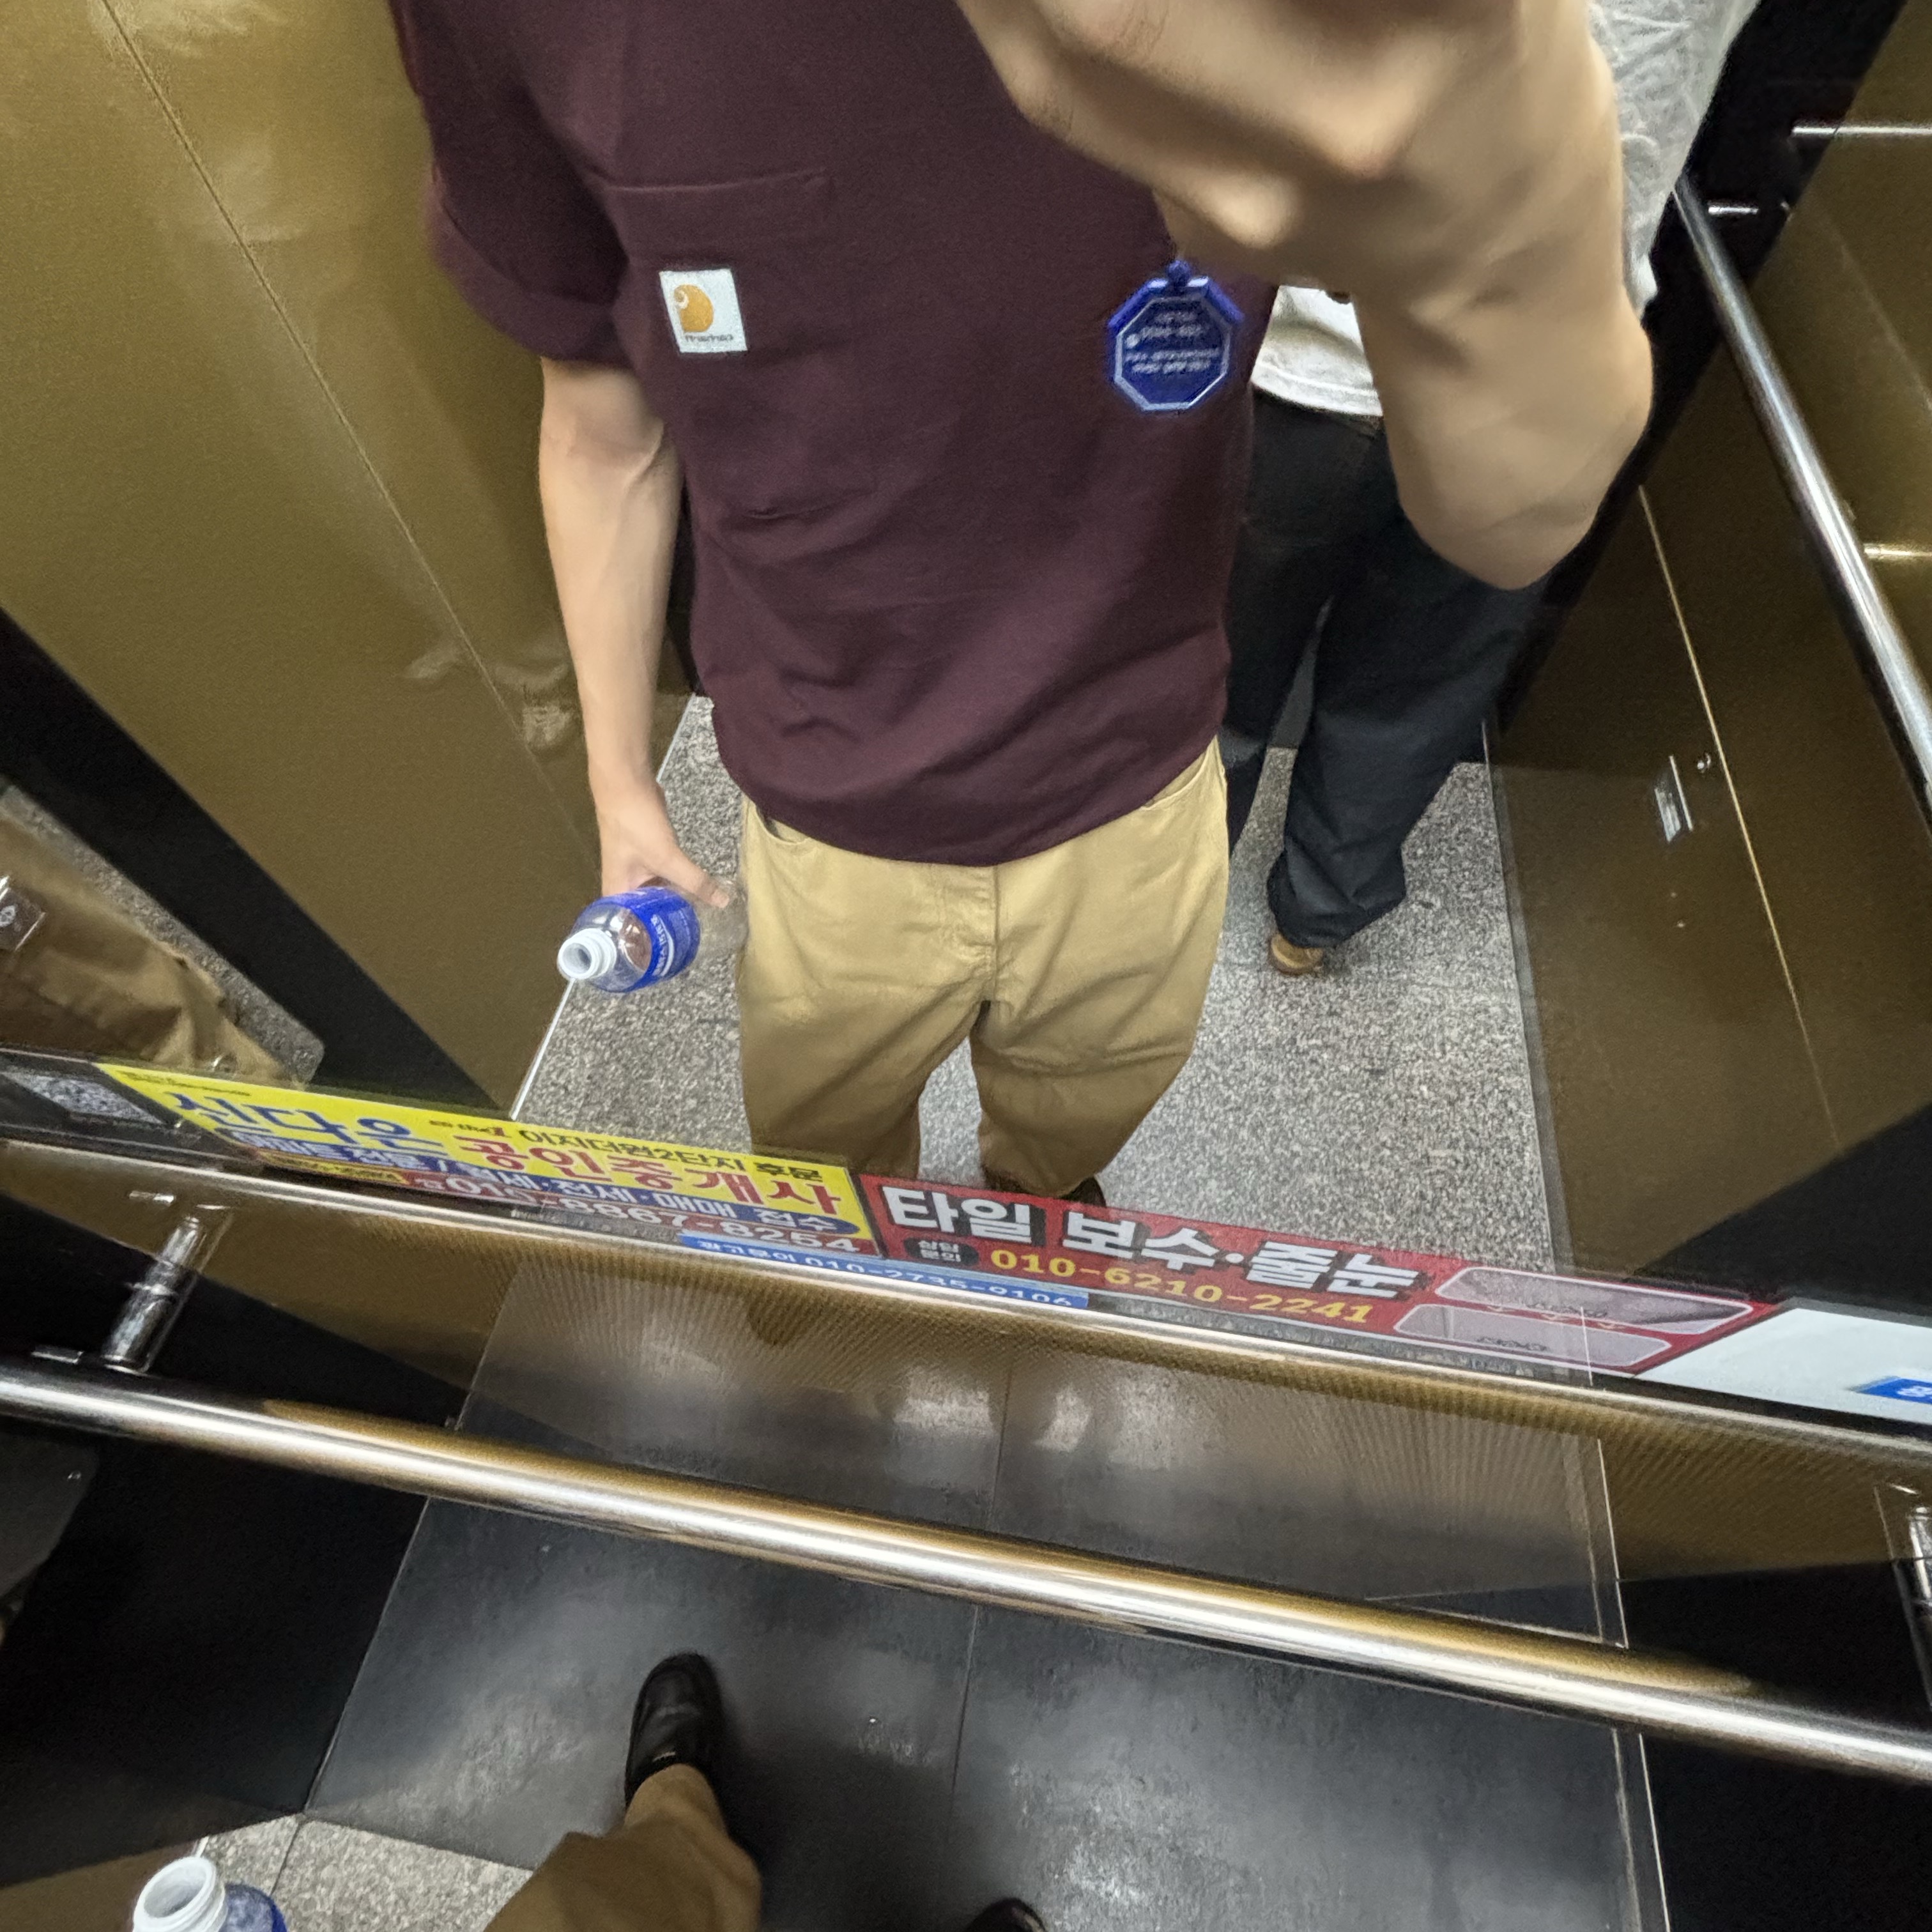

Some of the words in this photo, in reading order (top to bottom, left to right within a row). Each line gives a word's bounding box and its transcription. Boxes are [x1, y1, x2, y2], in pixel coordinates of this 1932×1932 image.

[164, 1091, 447, 1155] 신다온
[453, 1134, 841, 1215] 공인중개사
[756, 1162, 823, 1183] 후문
[756, 1208, 837, 1232] 접수
[881, 1185, 1032, 1245] 타일
[1061, 1211, 1419, 1301] 보수·줄눈
[991, 1249, 1370, 1324] 010-6210-2241
